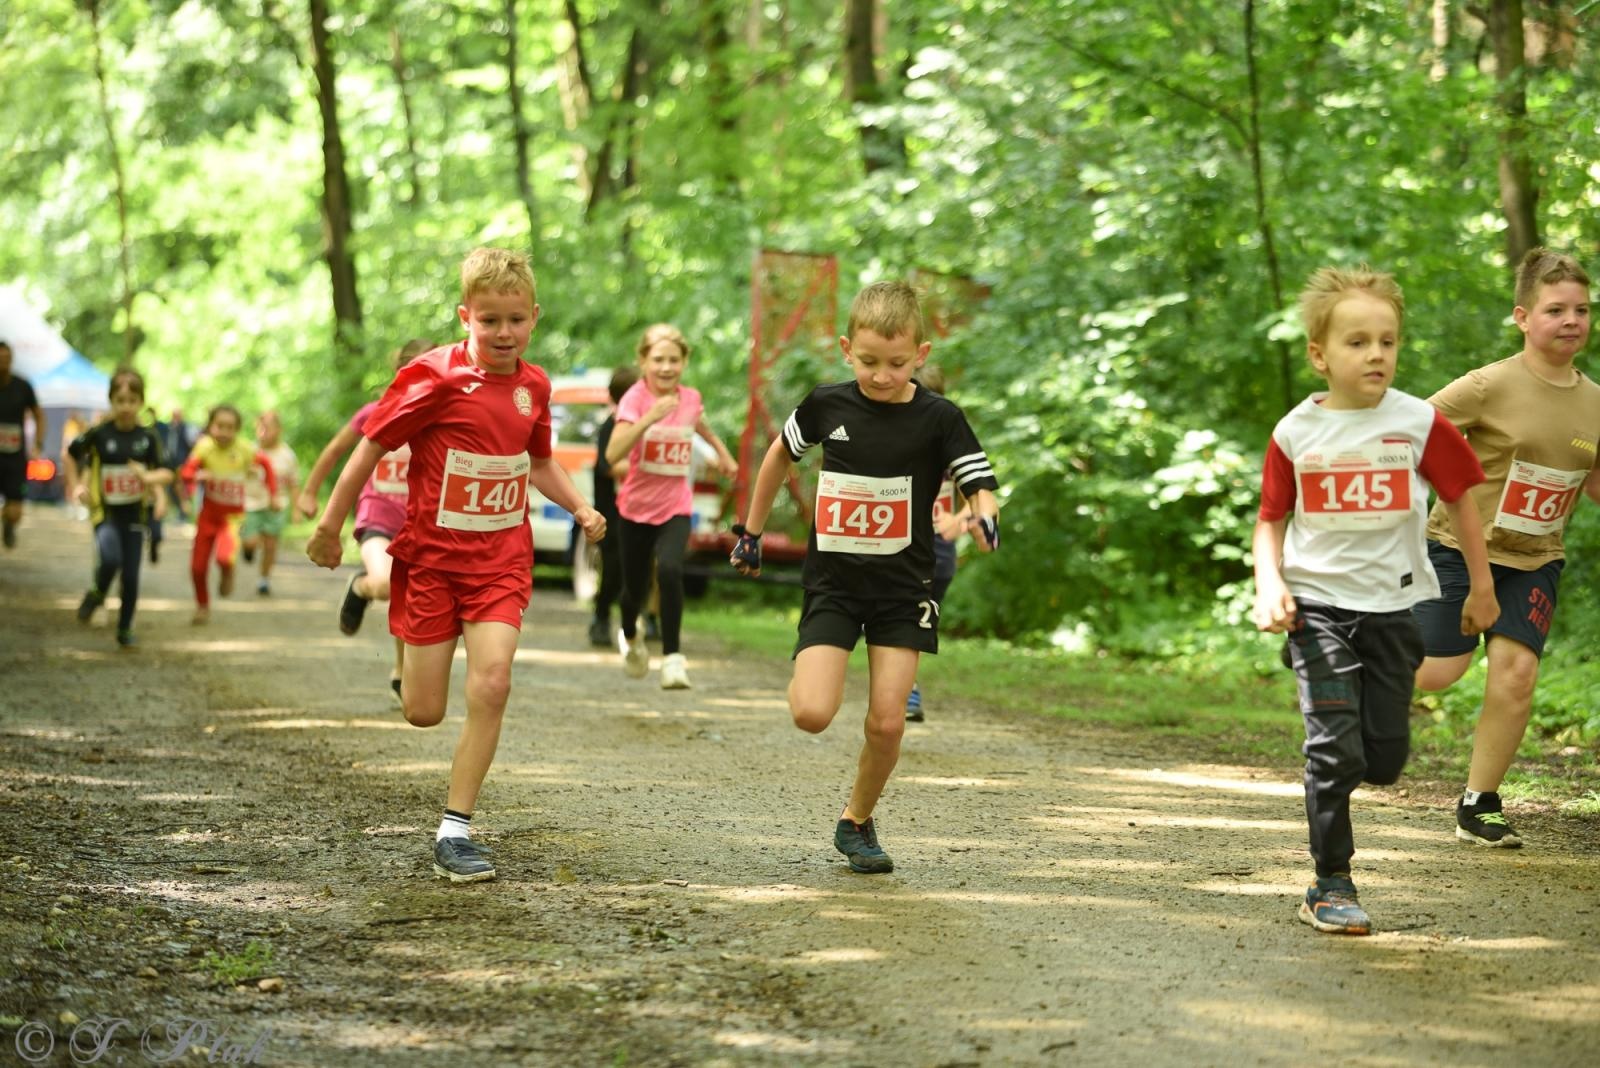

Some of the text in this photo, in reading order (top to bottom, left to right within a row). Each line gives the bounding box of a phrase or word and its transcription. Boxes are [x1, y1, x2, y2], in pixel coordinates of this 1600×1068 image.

[655, 443, 690, 465] 146
[462, 480, 520, 513] 140
[880, 488, 899, 497] 4500
[900, 487, 908, 495] M
[1319, 472, 1394, 511] 145
[826, 500, 895, 536] 149
